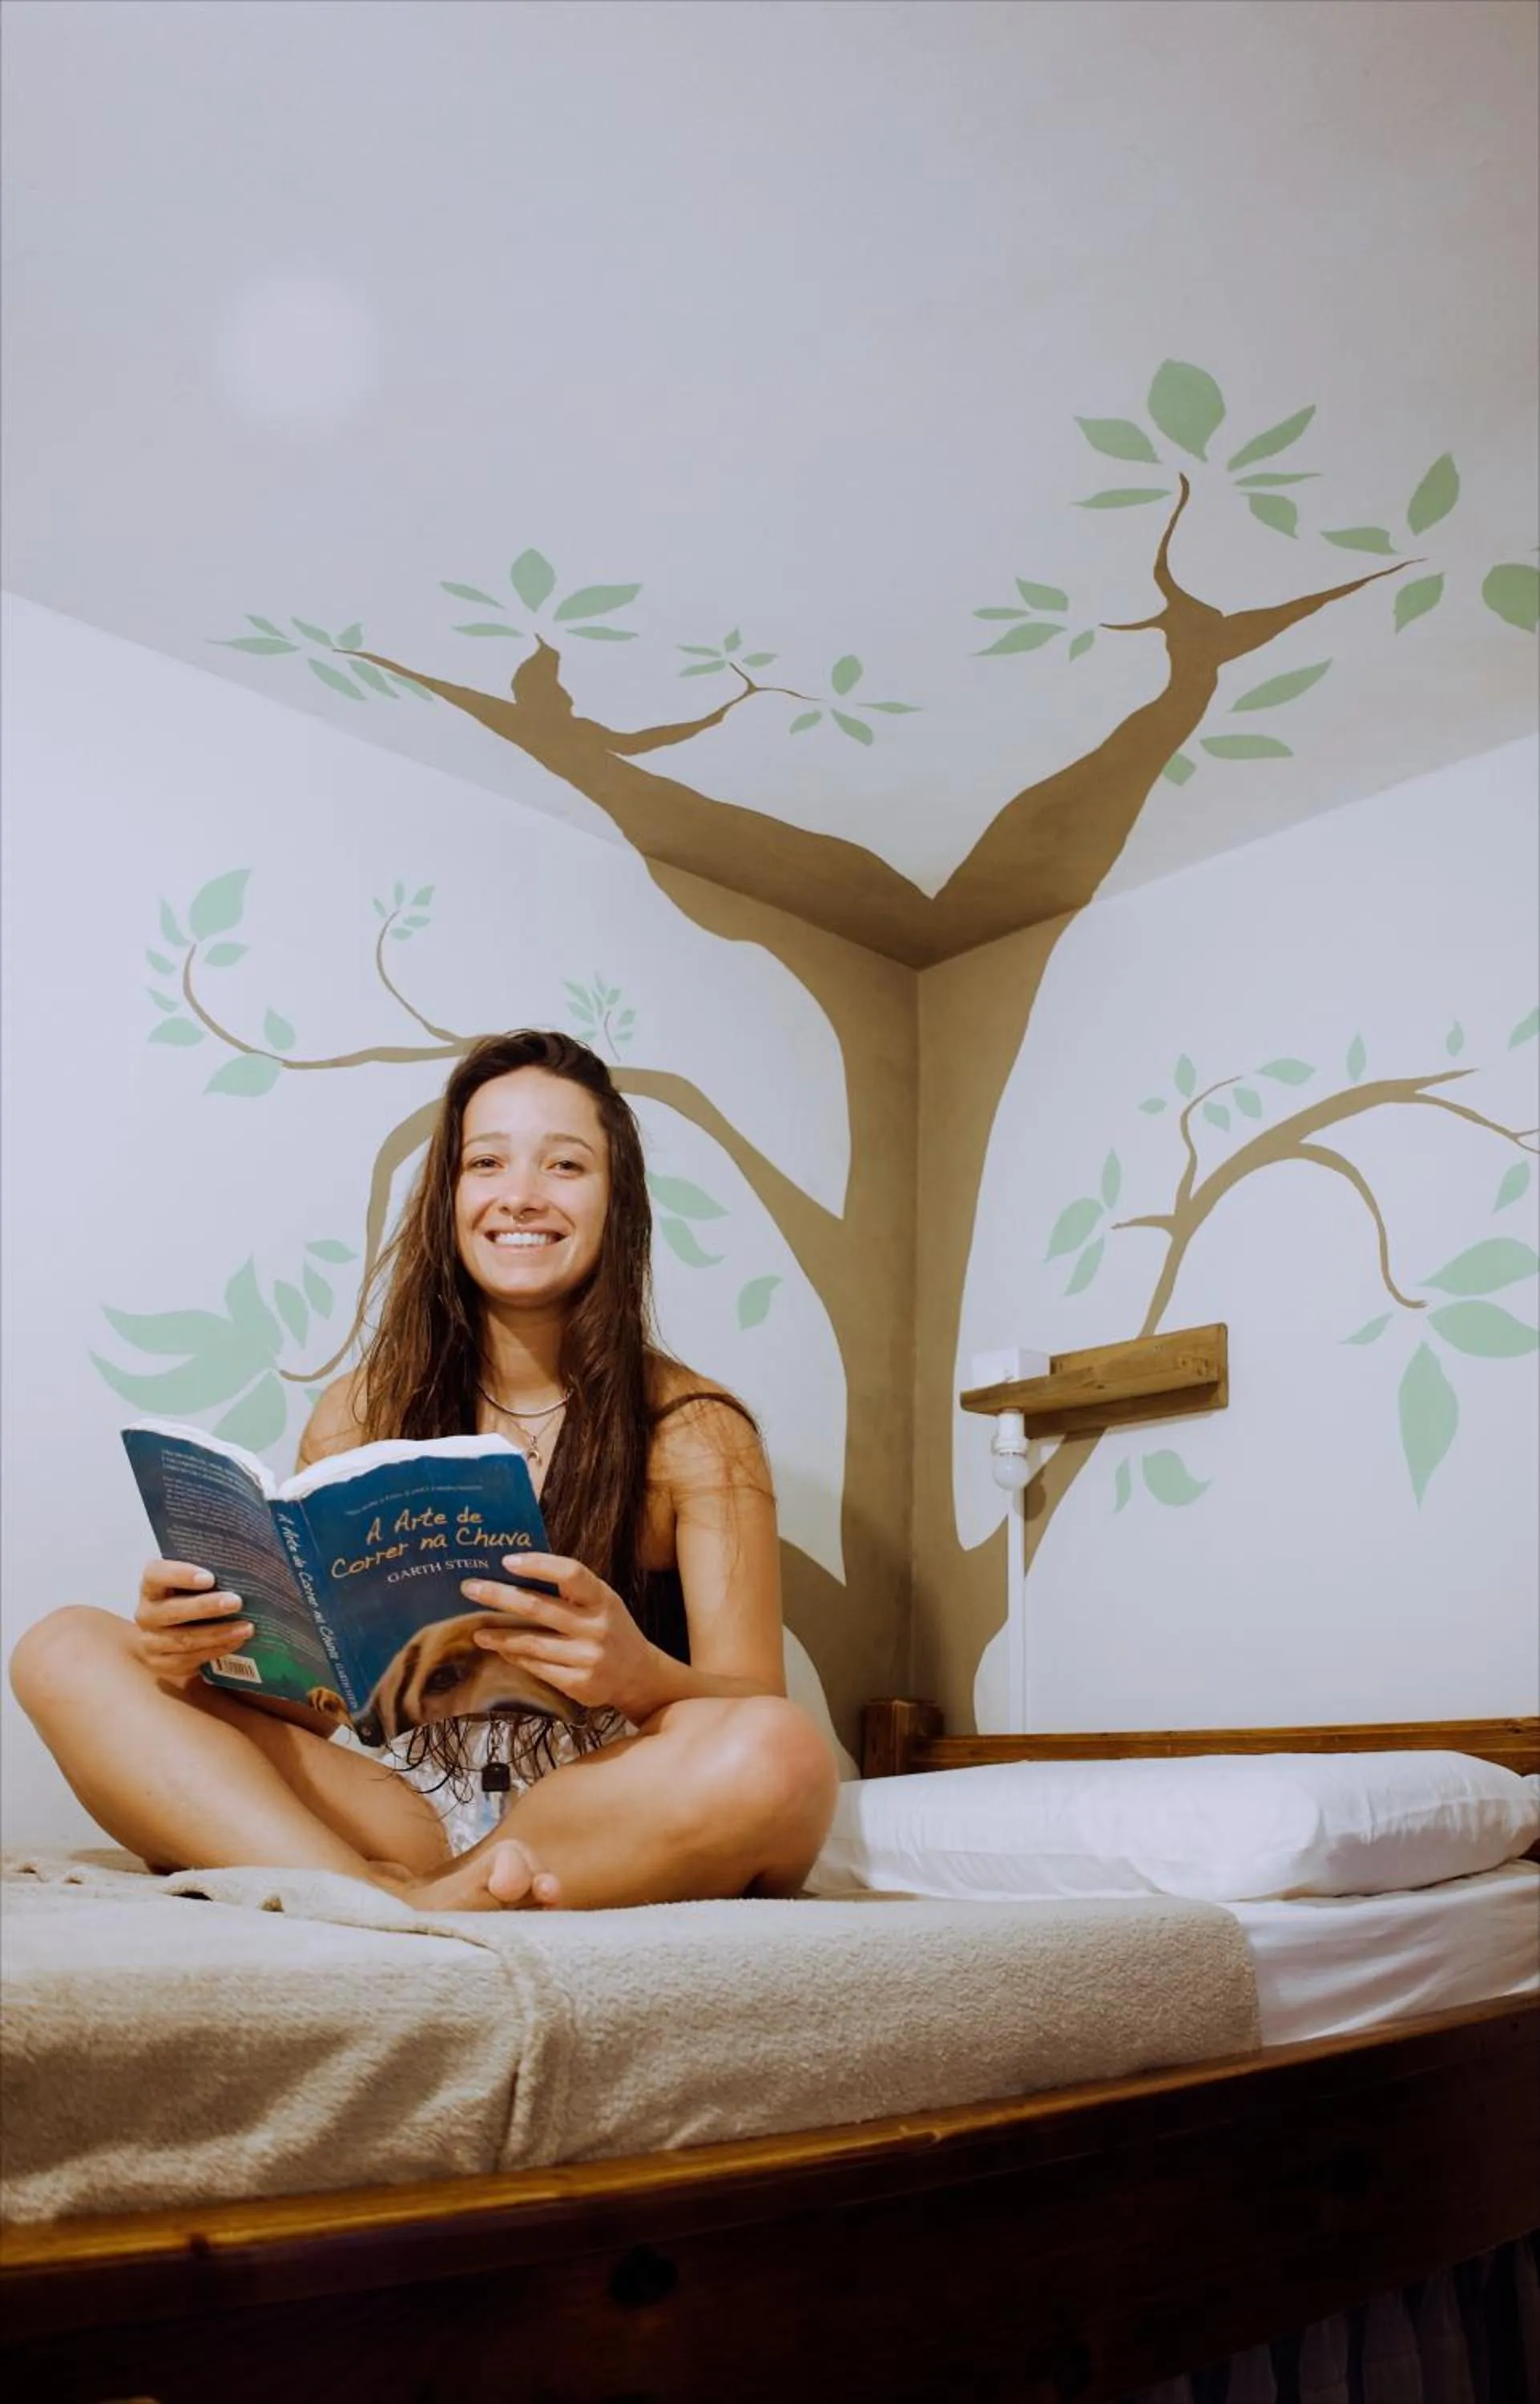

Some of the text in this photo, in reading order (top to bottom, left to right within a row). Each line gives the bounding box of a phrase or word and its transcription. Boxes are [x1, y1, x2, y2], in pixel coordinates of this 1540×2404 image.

[366, 1505, 483, 1546] A Arte de
[331, 1527, 531, 1579] Correr na Chuva
[387, 1559, 489, 1583] GARTH STEIN
